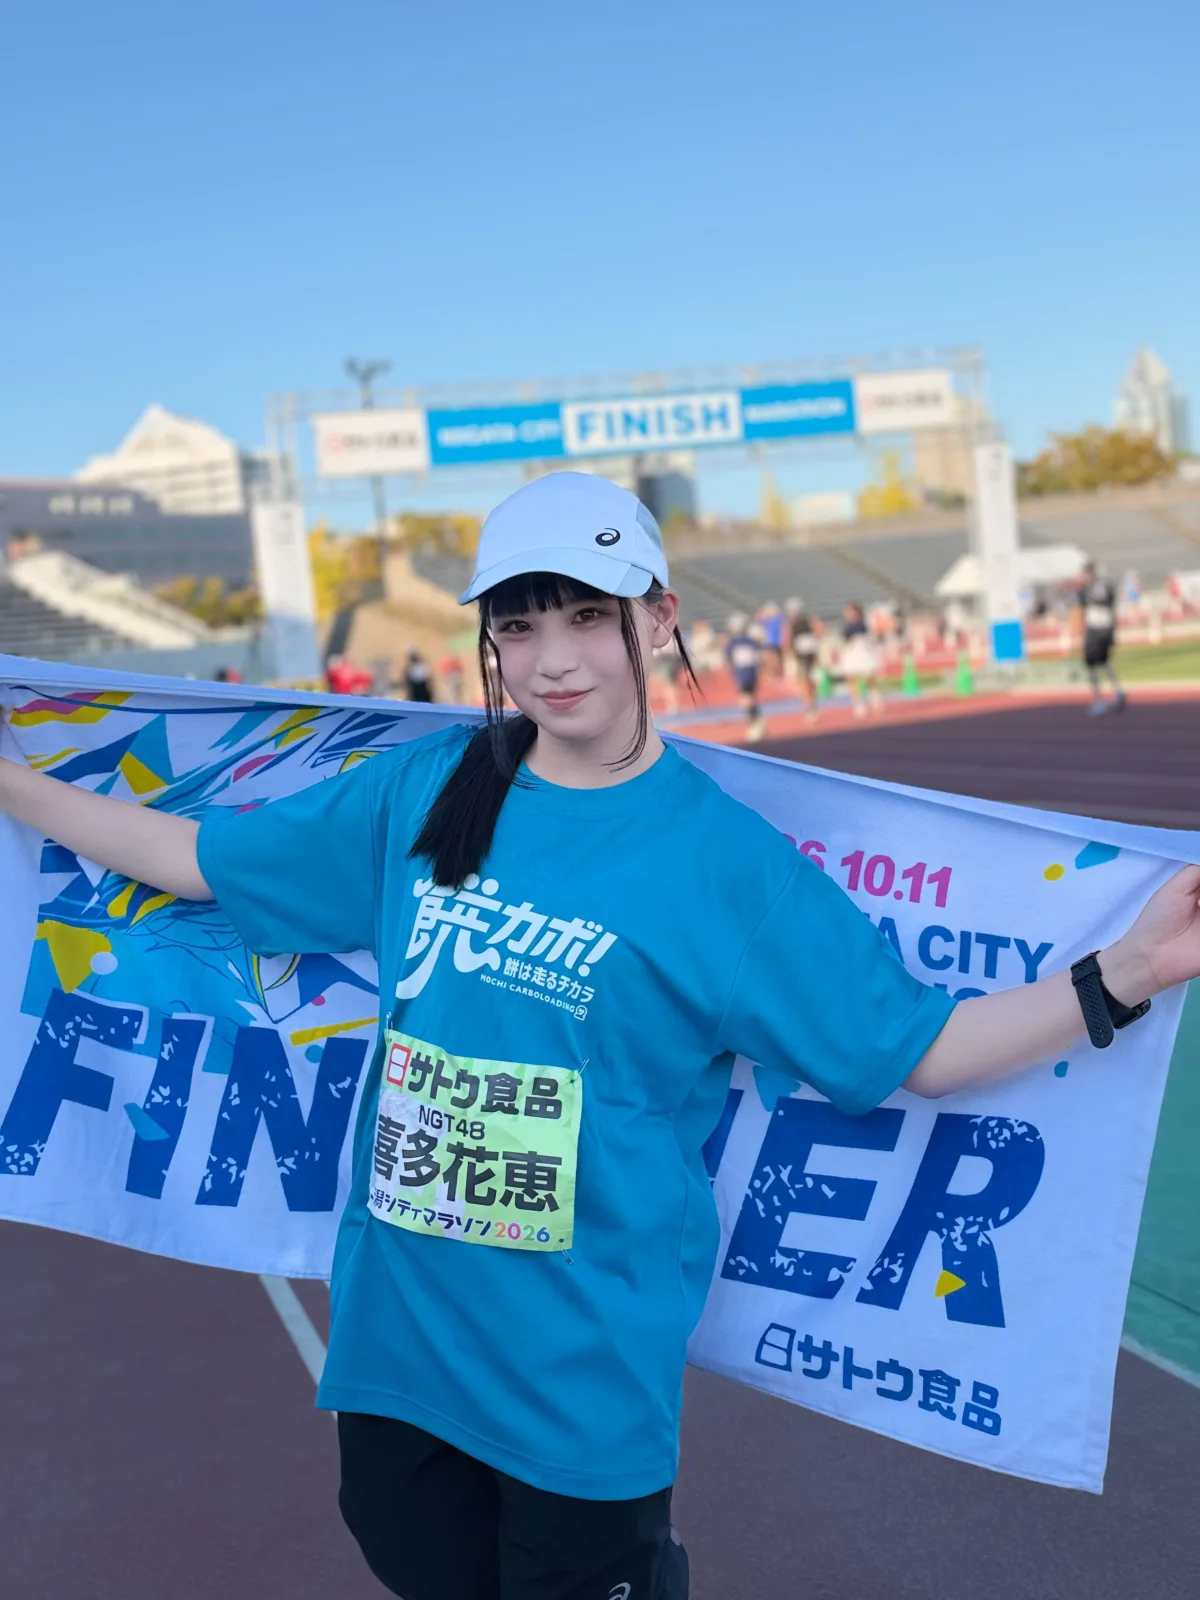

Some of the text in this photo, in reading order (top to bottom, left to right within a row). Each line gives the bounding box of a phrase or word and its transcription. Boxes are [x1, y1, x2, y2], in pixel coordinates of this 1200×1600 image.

[576, 399, 731, 444] FINISH
[918, 925, 1054, 984] CITY
[480, 974, 576, 1013] MOCHI CARBOLOADING
[503, 957, 595, 1003] 餅は走るチカラ
[418, 1104, 486, 1141] NGT48
[373, 1113, 563, 1213] 喜多花恵
